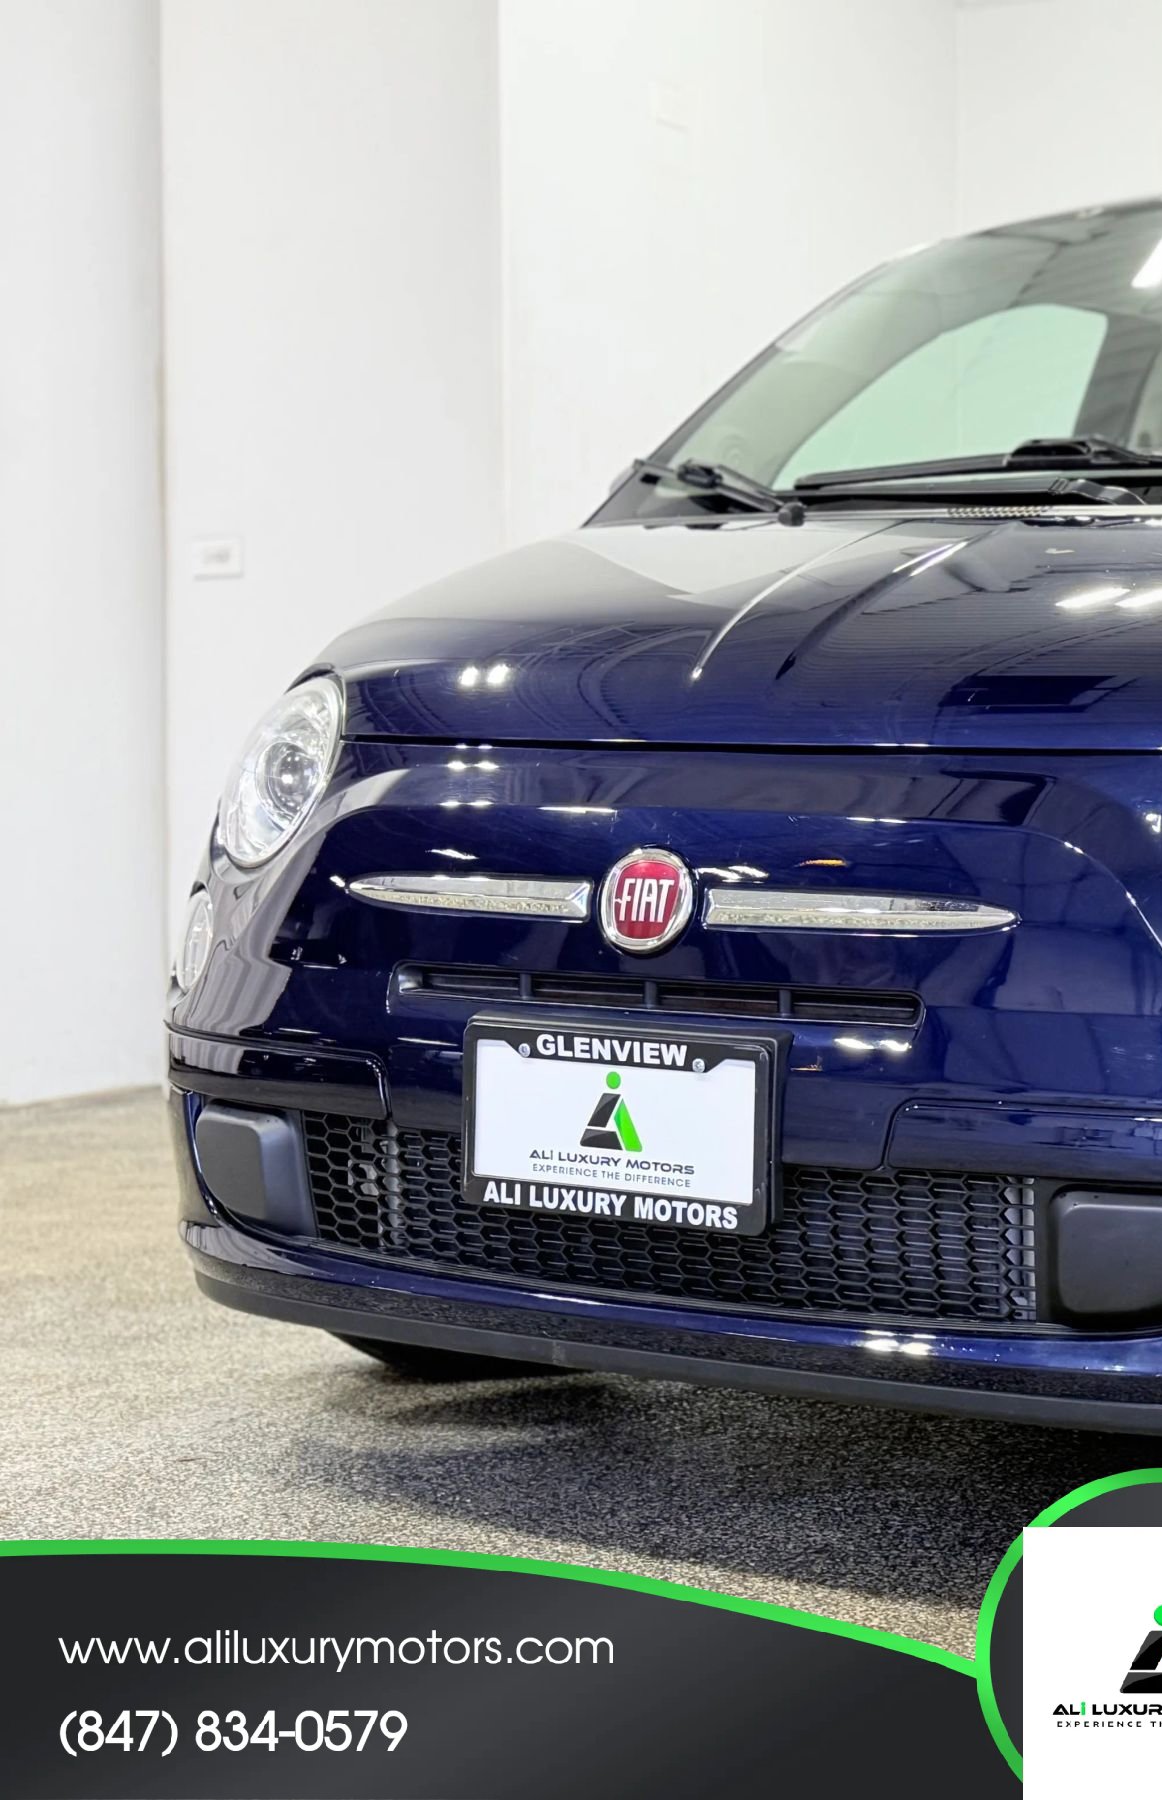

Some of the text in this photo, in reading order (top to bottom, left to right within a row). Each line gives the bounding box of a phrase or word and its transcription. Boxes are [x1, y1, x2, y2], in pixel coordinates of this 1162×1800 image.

[618, 878, 675, 923] FIAT
[536, 1034, 687, 1067] GLENVIEW
[532, 1163, 691, 1188] EXPERIENCE THE DIFFERENCE
[558, 1151, 621, 1167] LUXURY
[626, 1159, 695, 1175] MOTORS
[483, 1181, 738, 1230] ALI LUXURY MOTORS
